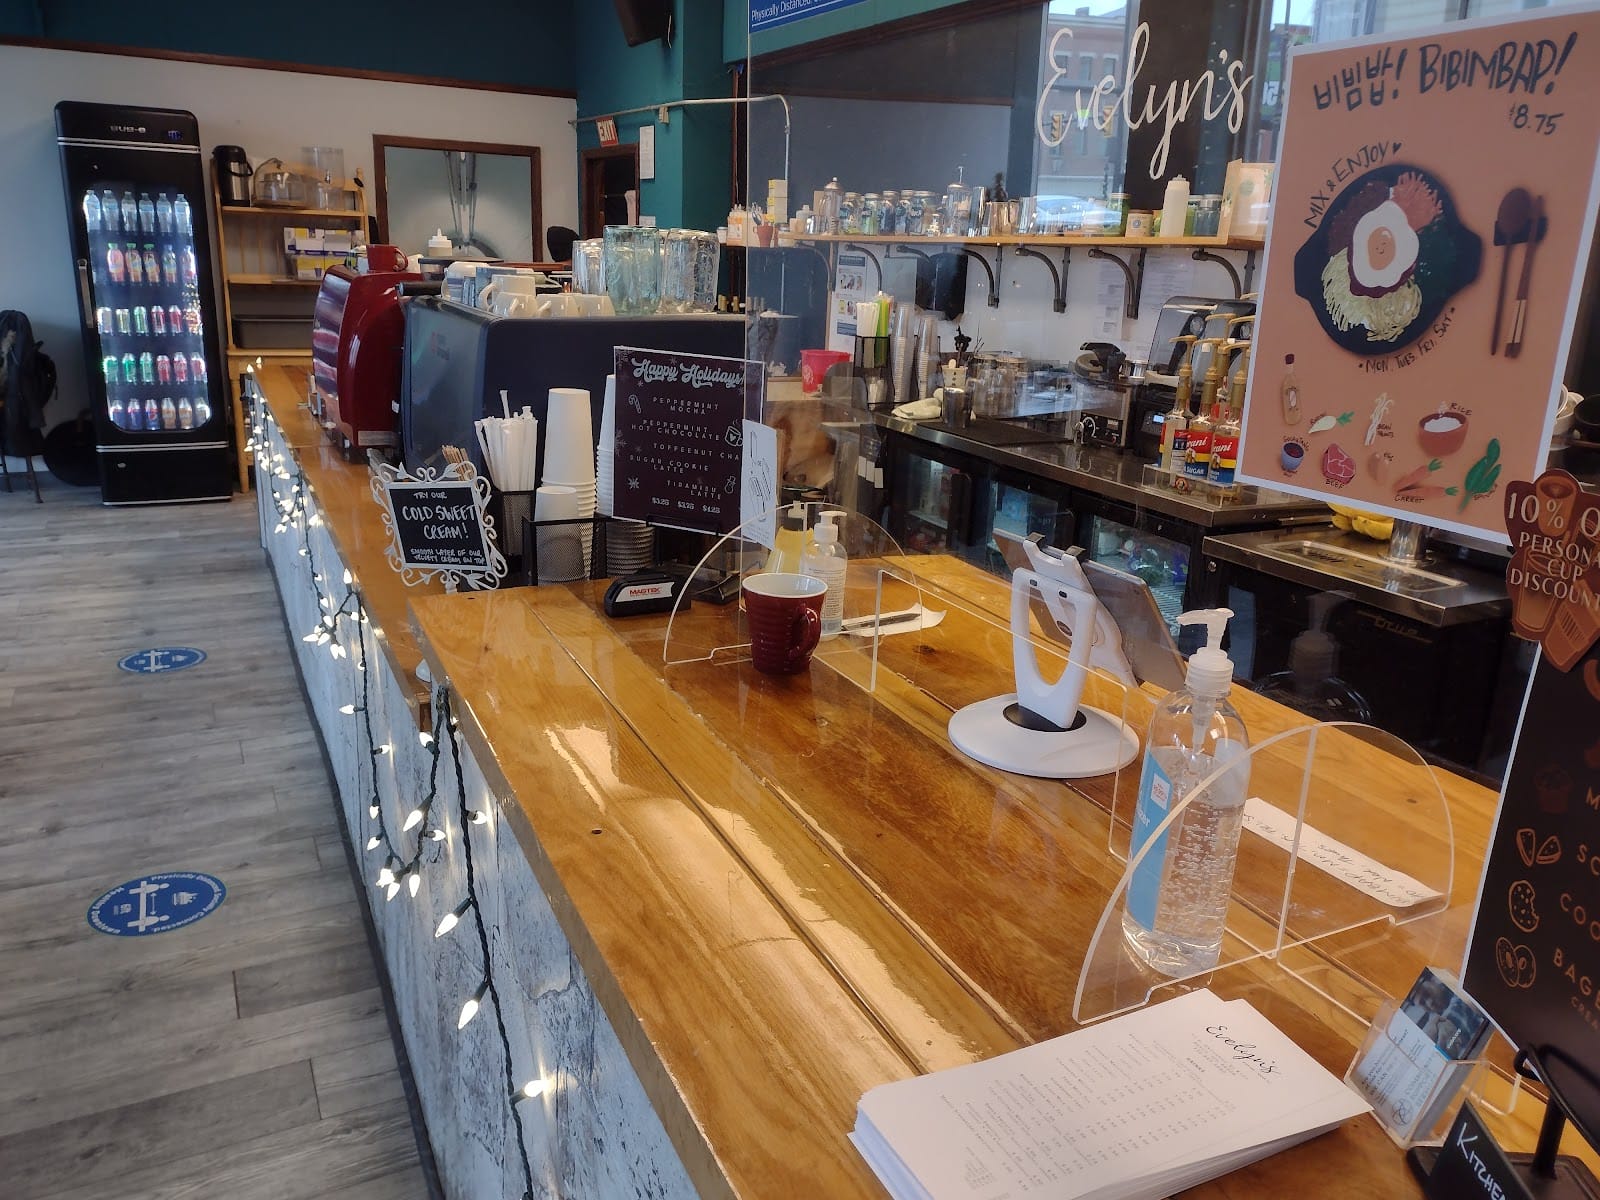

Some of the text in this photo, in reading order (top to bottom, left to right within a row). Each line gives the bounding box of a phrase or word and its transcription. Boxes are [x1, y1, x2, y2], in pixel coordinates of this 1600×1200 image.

[751, 3, 780, 22] Physically
[1419, 31, 1578, 96] BIBIMBAP!
[1037, 21, 1255, 180] Evelyn's
[1509, 103, 1564, 135] $8.75
[597, 119, 617, 141] EXIT
[1303, 189, 1330, 229] MIX
[1331, 140, 1390, 183] ENJOY
[631, 357, 679, 383] Happy
[653, 396, 719, 410] PEPPERMINT
[670, 405, 706, 415] MOCHA
[631, 423, 721, 441] HOT CHOCOLATE
[642, 419, 709, 433] PEPPERMINT
[653, 442, 713, 457] TOFFEENUT
[629, 454, 710, 472] SUGAR COOKIE
[653, 464, 684, 474] LATTE
[413, 491, 448, 500] TRY OUR
[666, 480, 717, 493] TIRAMISU
[690, 490, 722, 500] LATTE
[402, 504, 477, 522] COLD SWEET
[1508, 491, 1564, 530] 10%
[423, 521, 469, 540] CREAM!
[1547, 558, 1583, 582] CUP
[1206, 1025, 1283, 1075] Evelyn's
